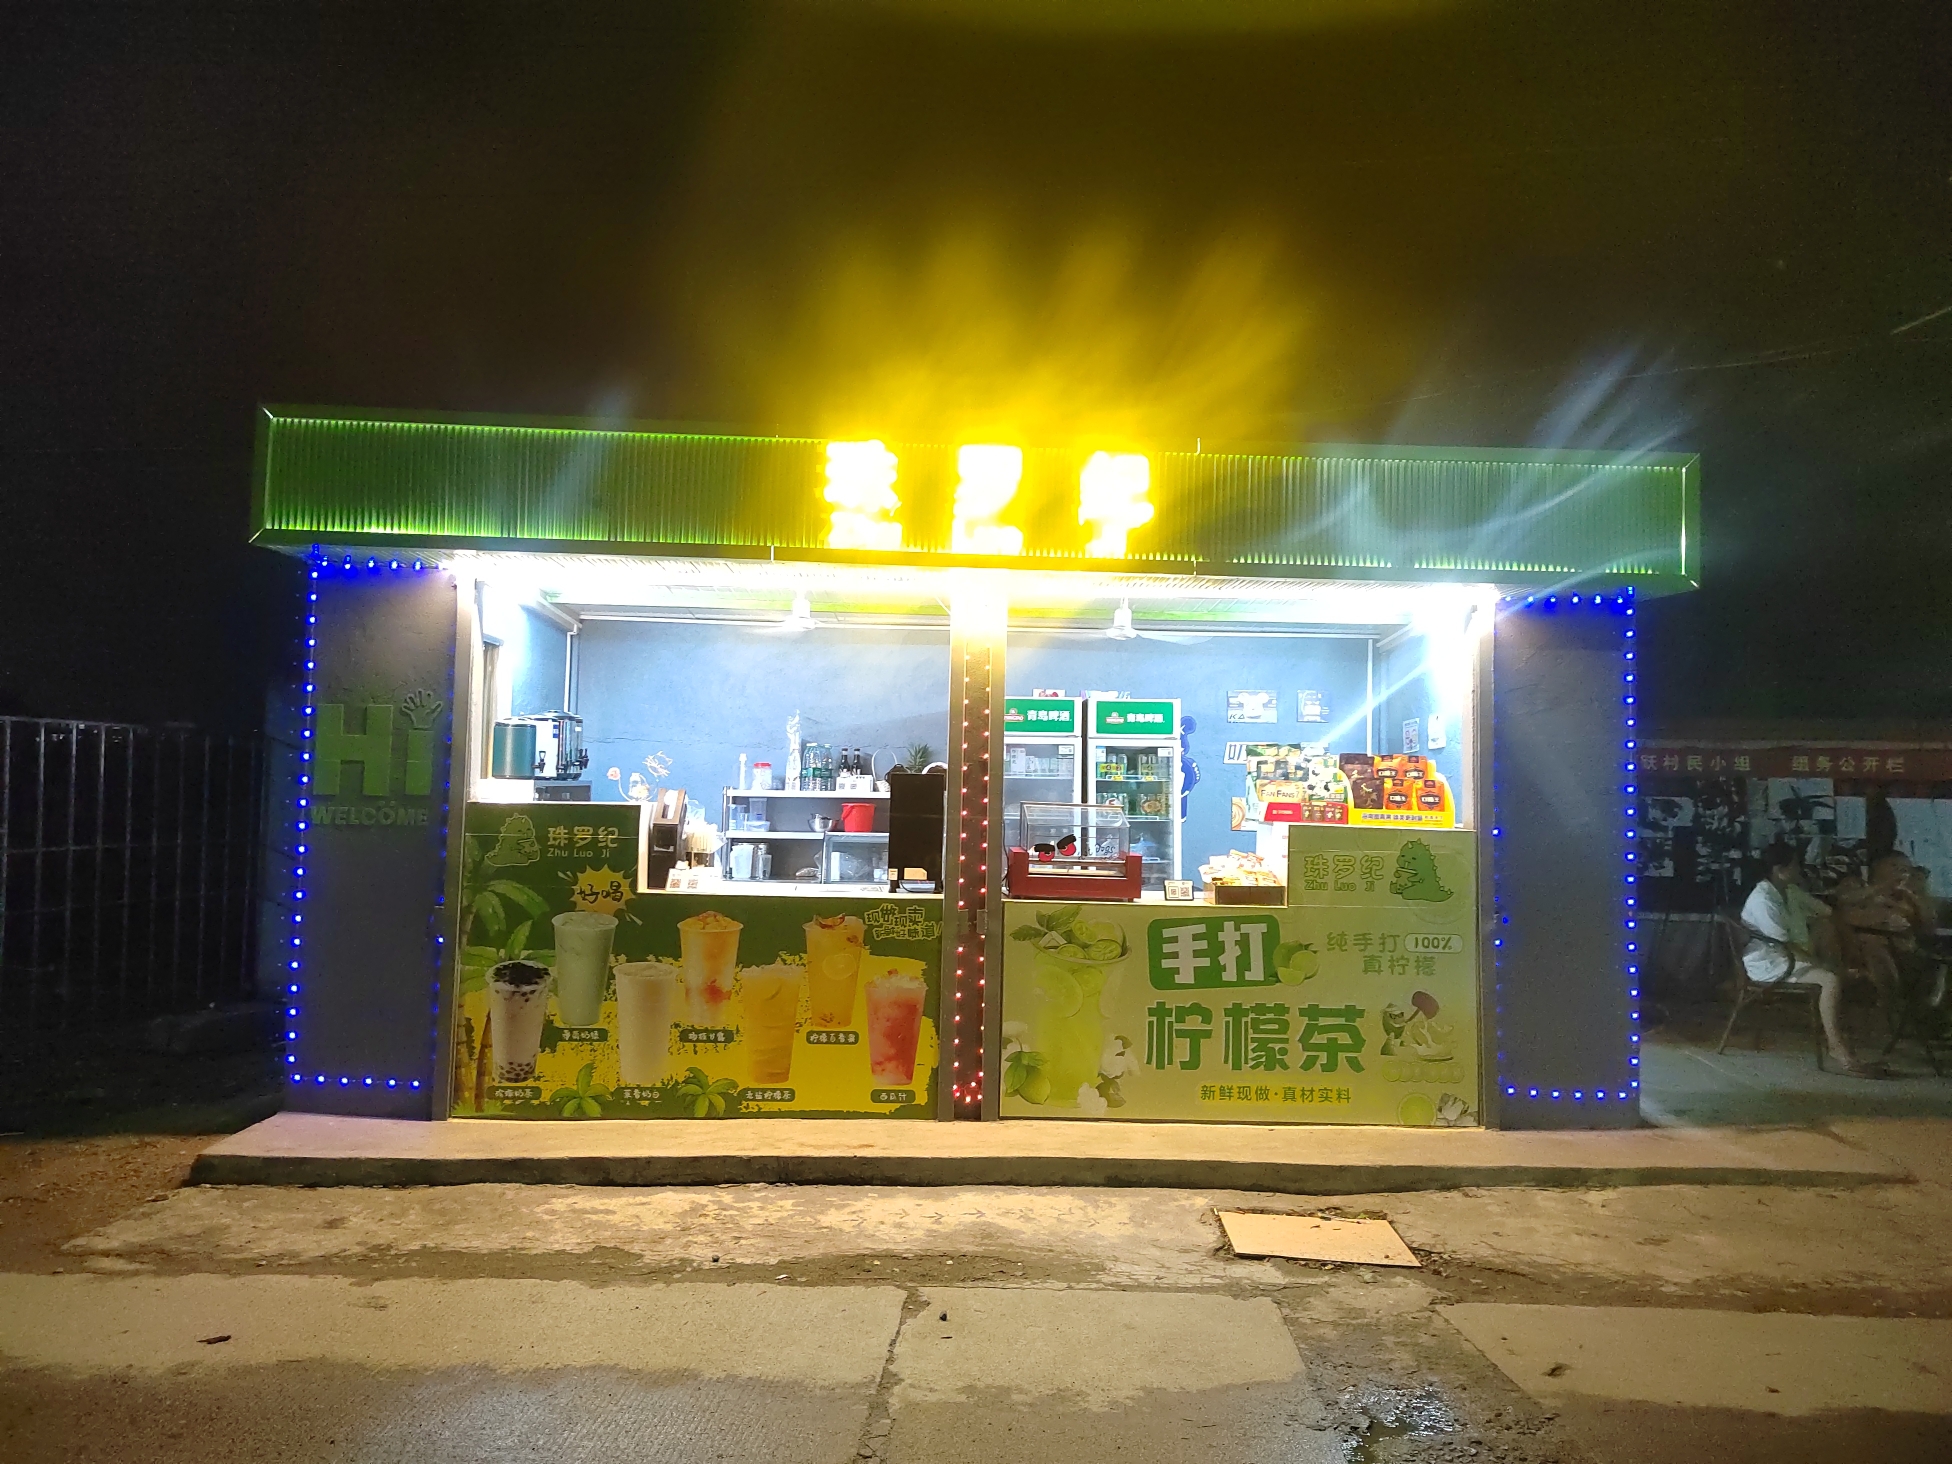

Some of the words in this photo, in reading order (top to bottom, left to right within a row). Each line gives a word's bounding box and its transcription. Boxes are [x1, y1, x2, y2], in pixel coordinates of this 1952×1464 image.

[1027, 710, 1069, 722] 青岛啤酒
[313, 704, 434, 796] Hi
[547, 825, 619, 848] 珠罗纪
[547, 848, 568, 857] Zhu
[574, 849, 593, 858] Luo
[601, 849, 610, 858] Ji
[1304, 854, 1384, 880] 珠罗纪
[577, 880, 623, 904] 好喝
[1304, 879, 1328, 891] Zhu
[1334, 880, 1357, 892] Luo
[1365, 881, 1375, 892] Ji
[865, 903, 925, 928] 现做现卖
[1161, 921, 1268, 984] 手打
[1327, 931, 1401, 953] 纯手打
[1413, 936, 1453, 951] 100%
[1362, 954, 1437, 976] 真柠檬
[810, 1033, 856, 1043] 柠檬百香果
[1145, 1000, 1366, 1074] 柠檬茶
[879, 1092, 907, 1101] 西瓜汁
